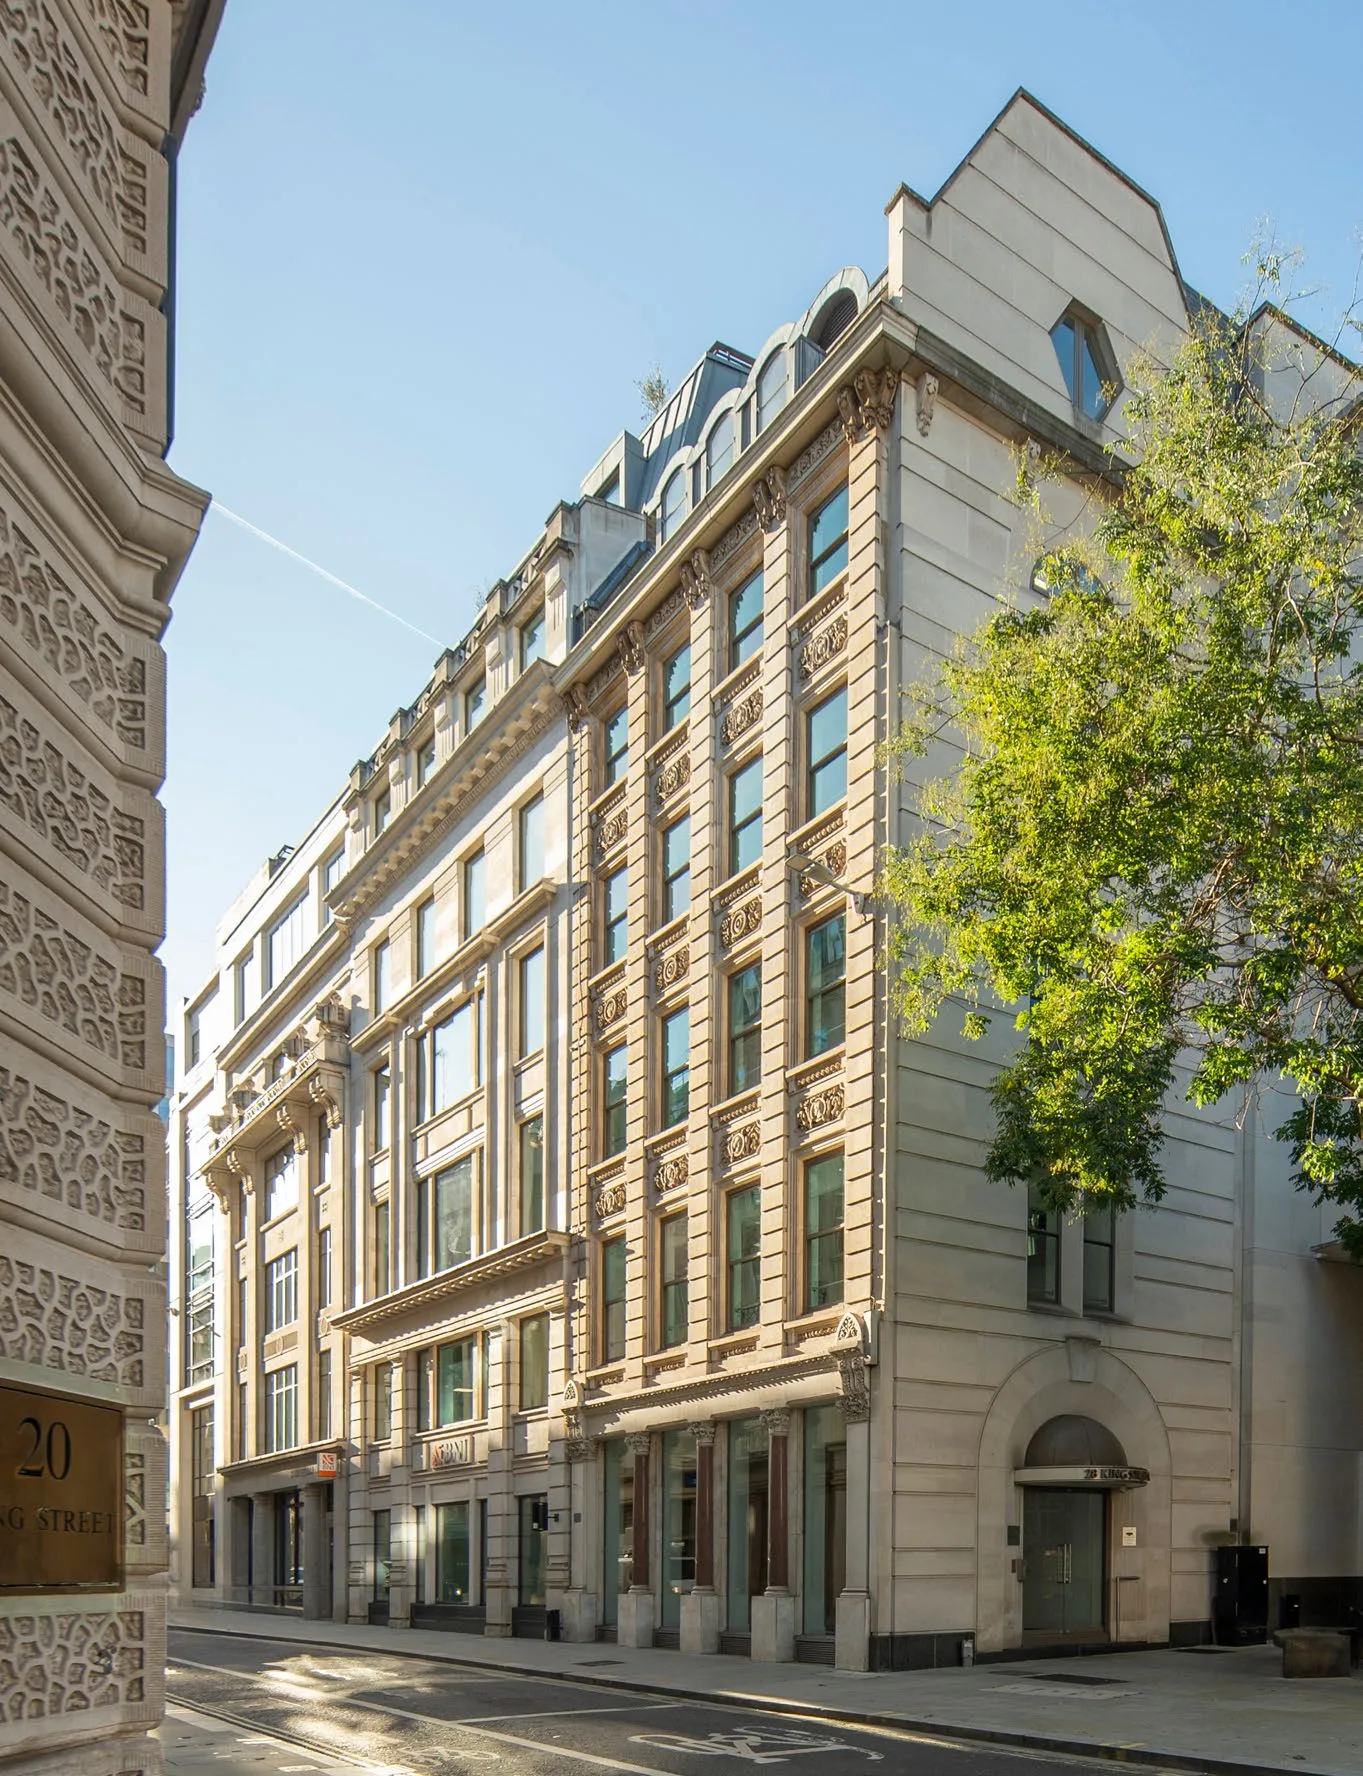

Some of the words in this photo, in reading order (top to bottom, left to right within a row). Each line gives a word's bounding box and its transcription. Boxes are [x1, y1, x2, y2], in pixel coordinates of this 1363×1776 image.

[17, 1417, 71, 1480] 20
[1100, 1469, 1128, 1479] KING
[38, 1507, 114, 1534] STREET
